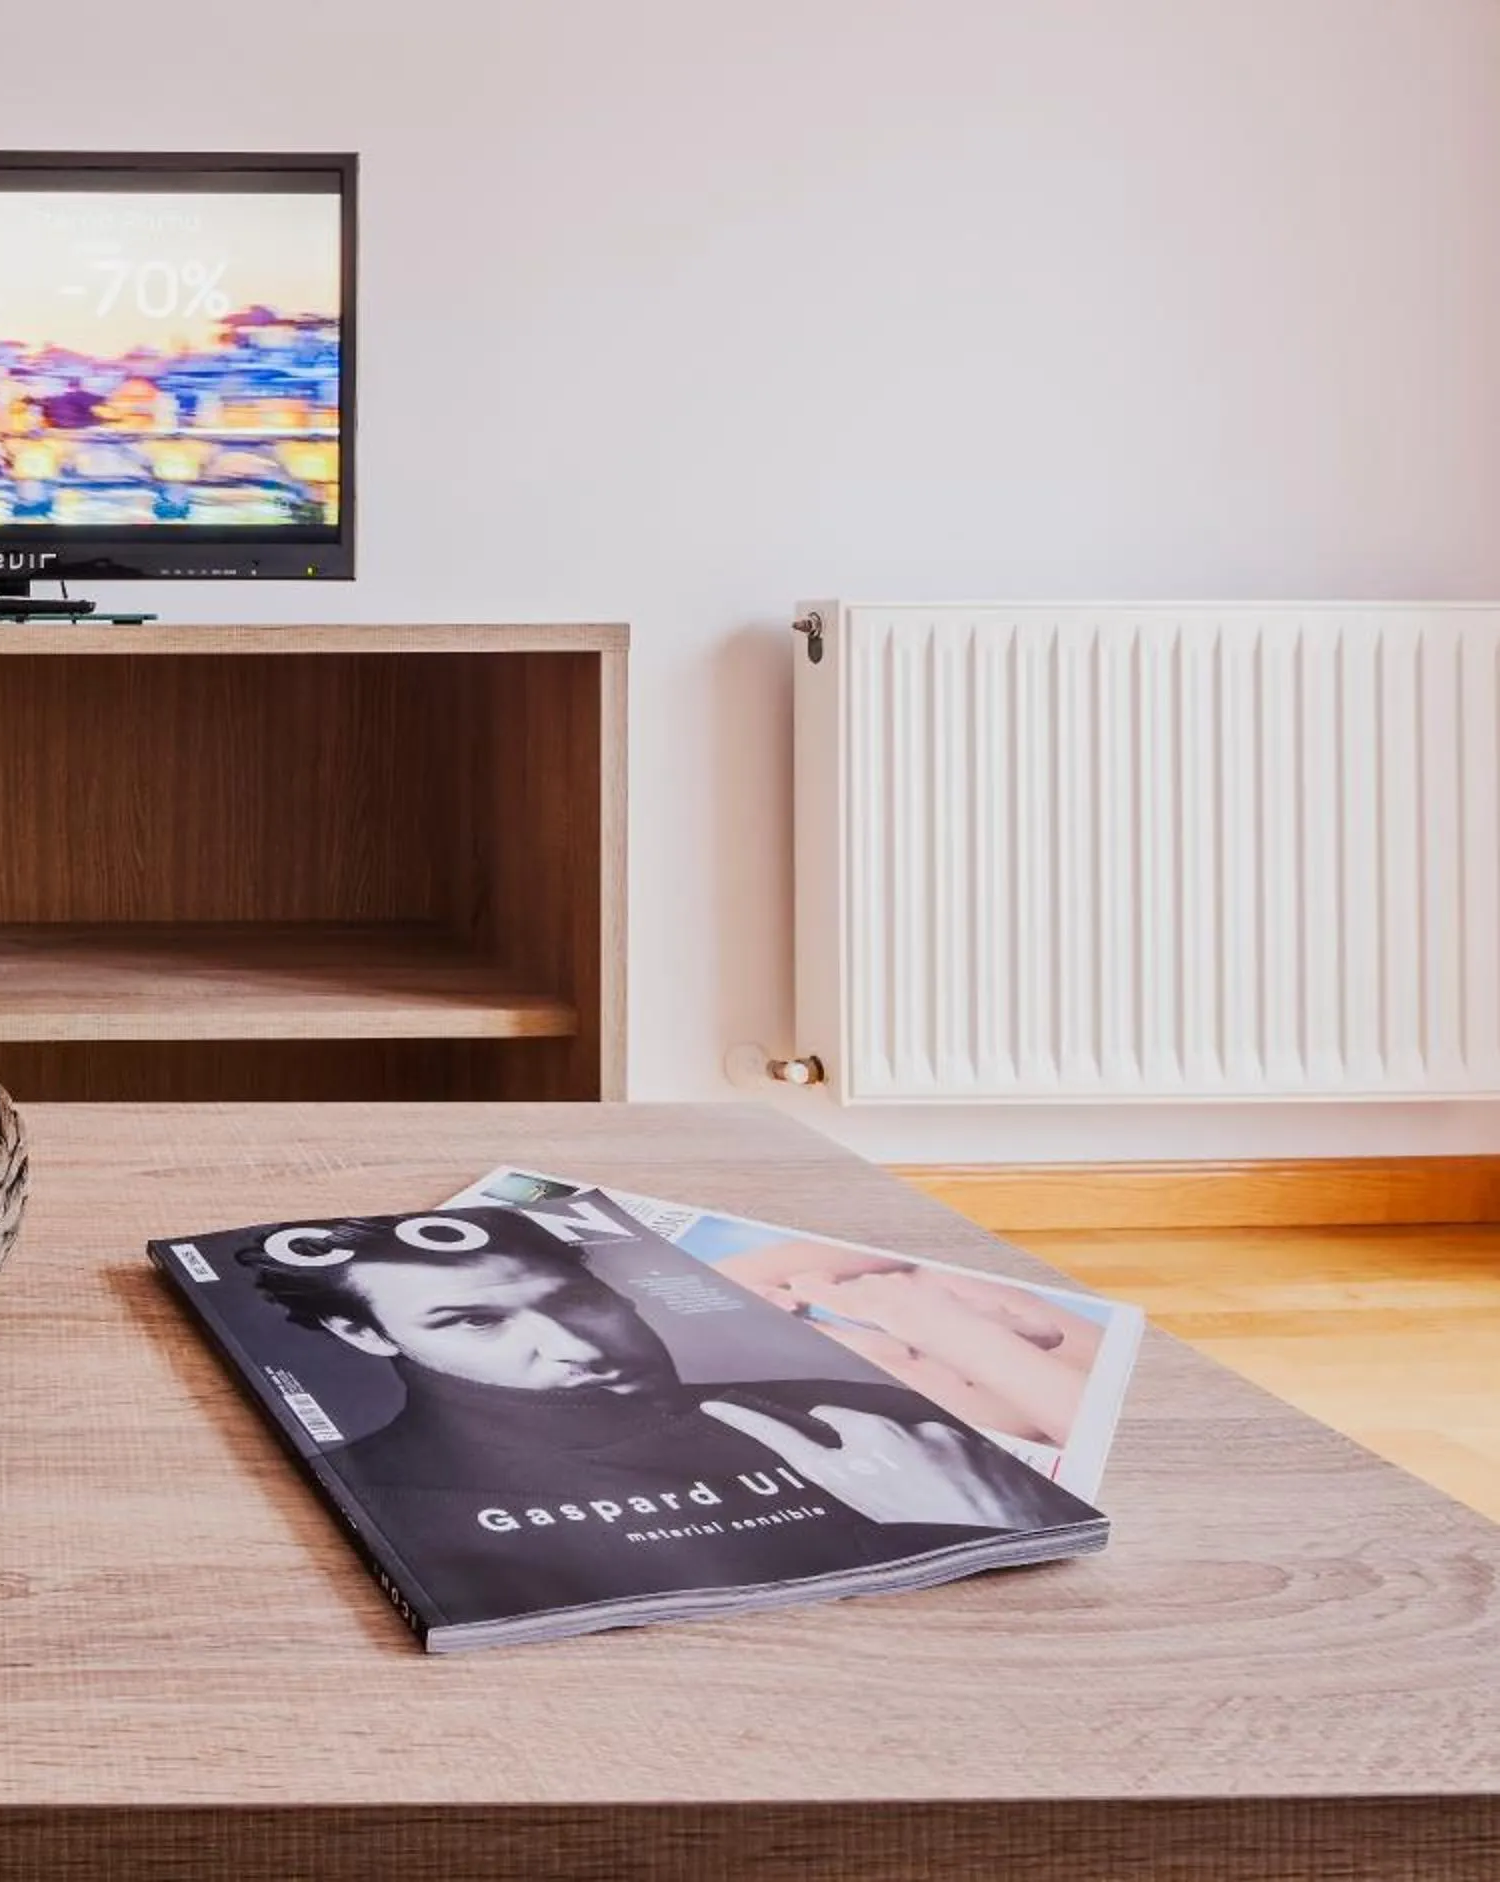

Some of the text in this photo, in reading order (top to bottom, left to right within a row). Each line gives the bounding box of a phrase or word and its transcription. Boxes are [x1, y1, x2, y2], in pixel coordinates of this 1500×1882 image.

[59, 254, 230, 318] -70%
[477, 1482, 723, 1533] Gaspard
[626, 1506, 826, 1545] material sensible
